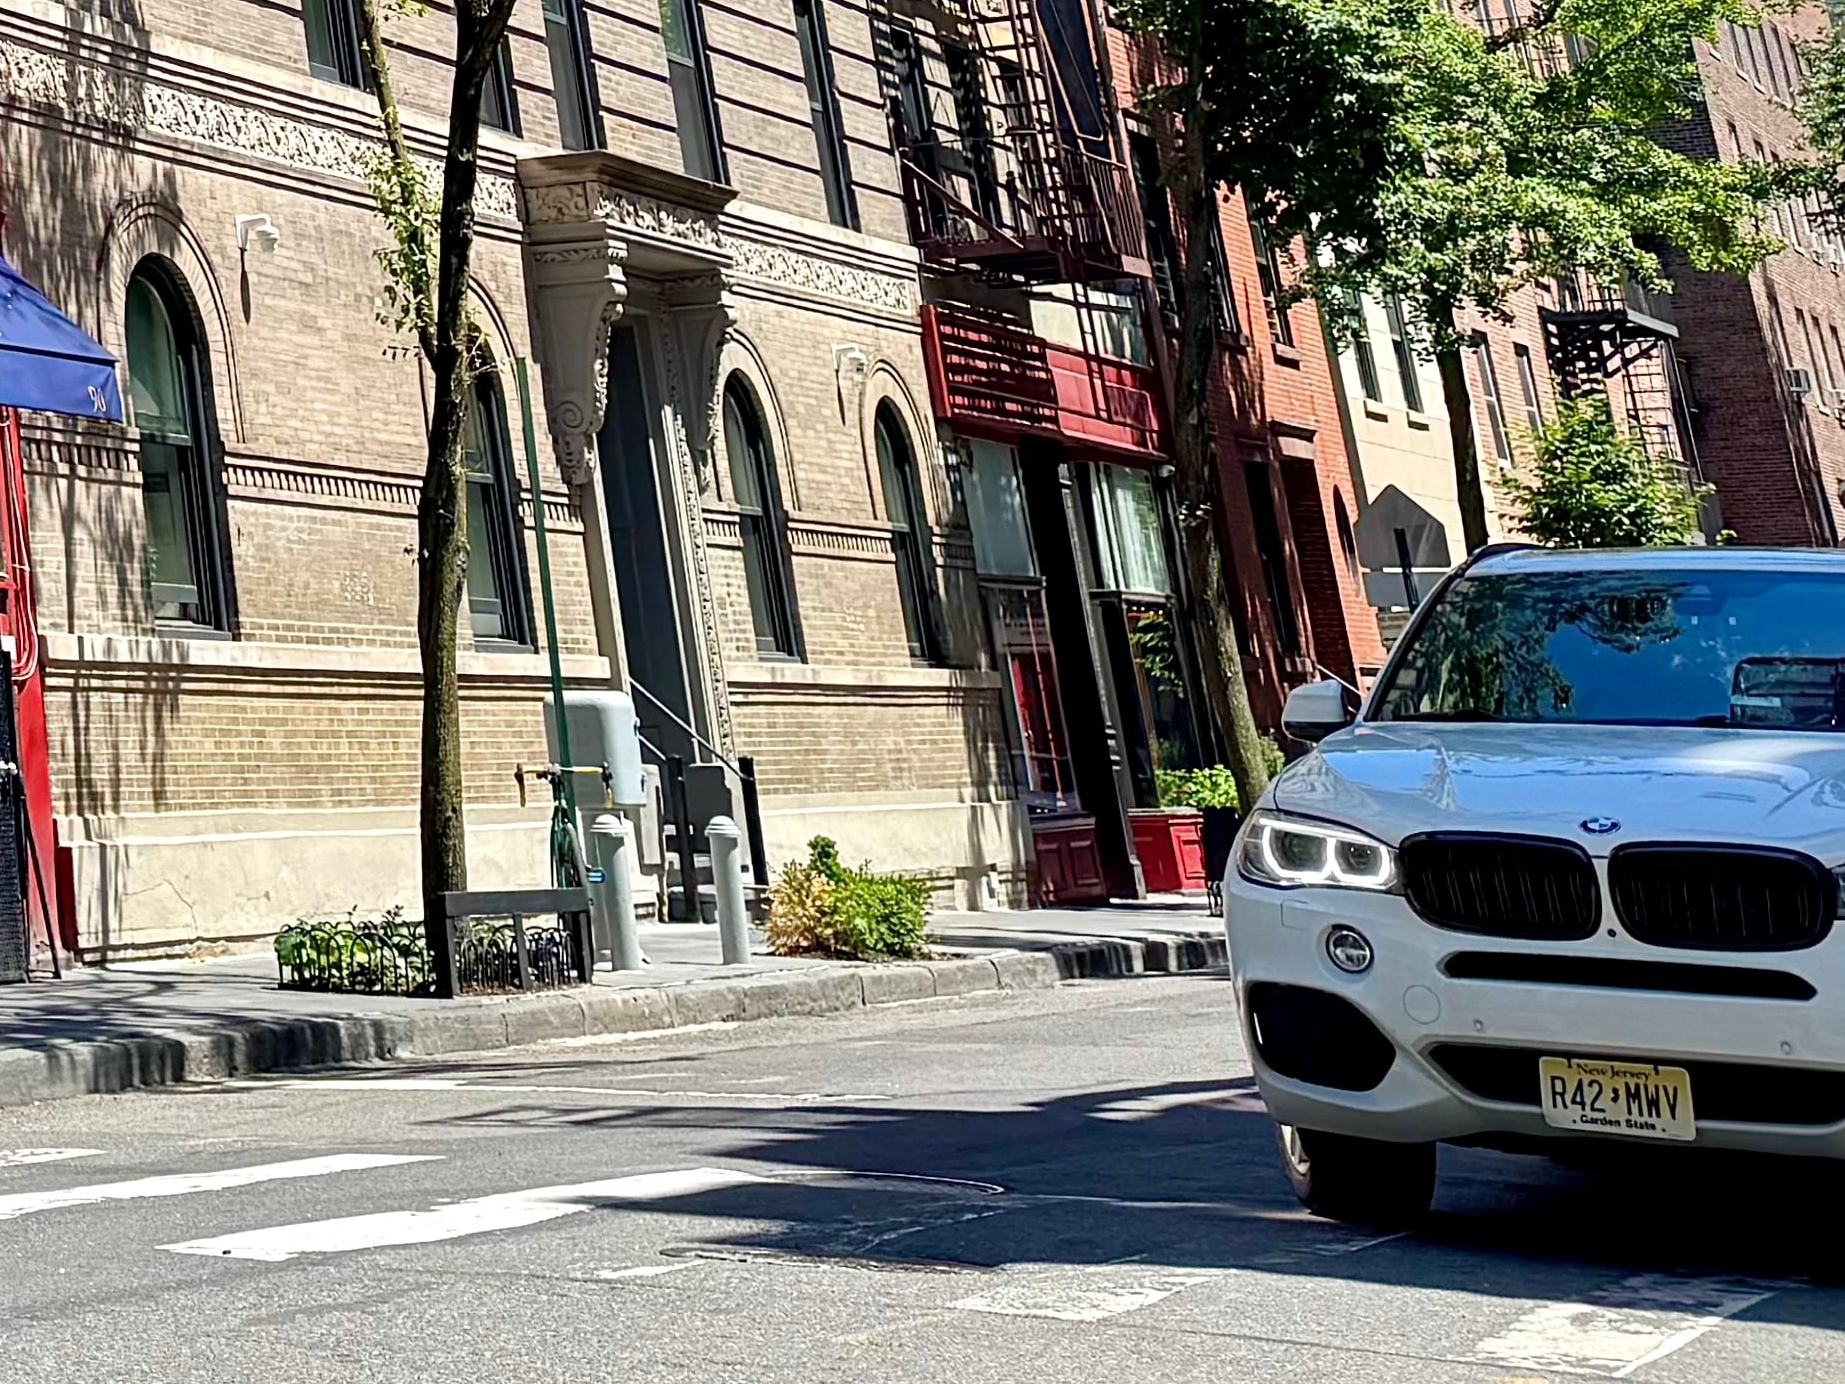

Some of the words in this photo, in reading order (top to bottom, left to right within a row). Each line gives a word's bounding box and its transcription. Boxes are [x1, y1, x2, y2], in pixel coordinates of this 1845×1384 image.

[1576, 1062, 1608, 1076] New
[1609, 1065, 1651, 1081] Jersey
[1550, 1075, 1606, 1113] R42
[1624, 1080, 1678, 1121] MWV
[1580, 1114, 1621, 1128] Garden
[1625, 1118, 1657, 1131] State
